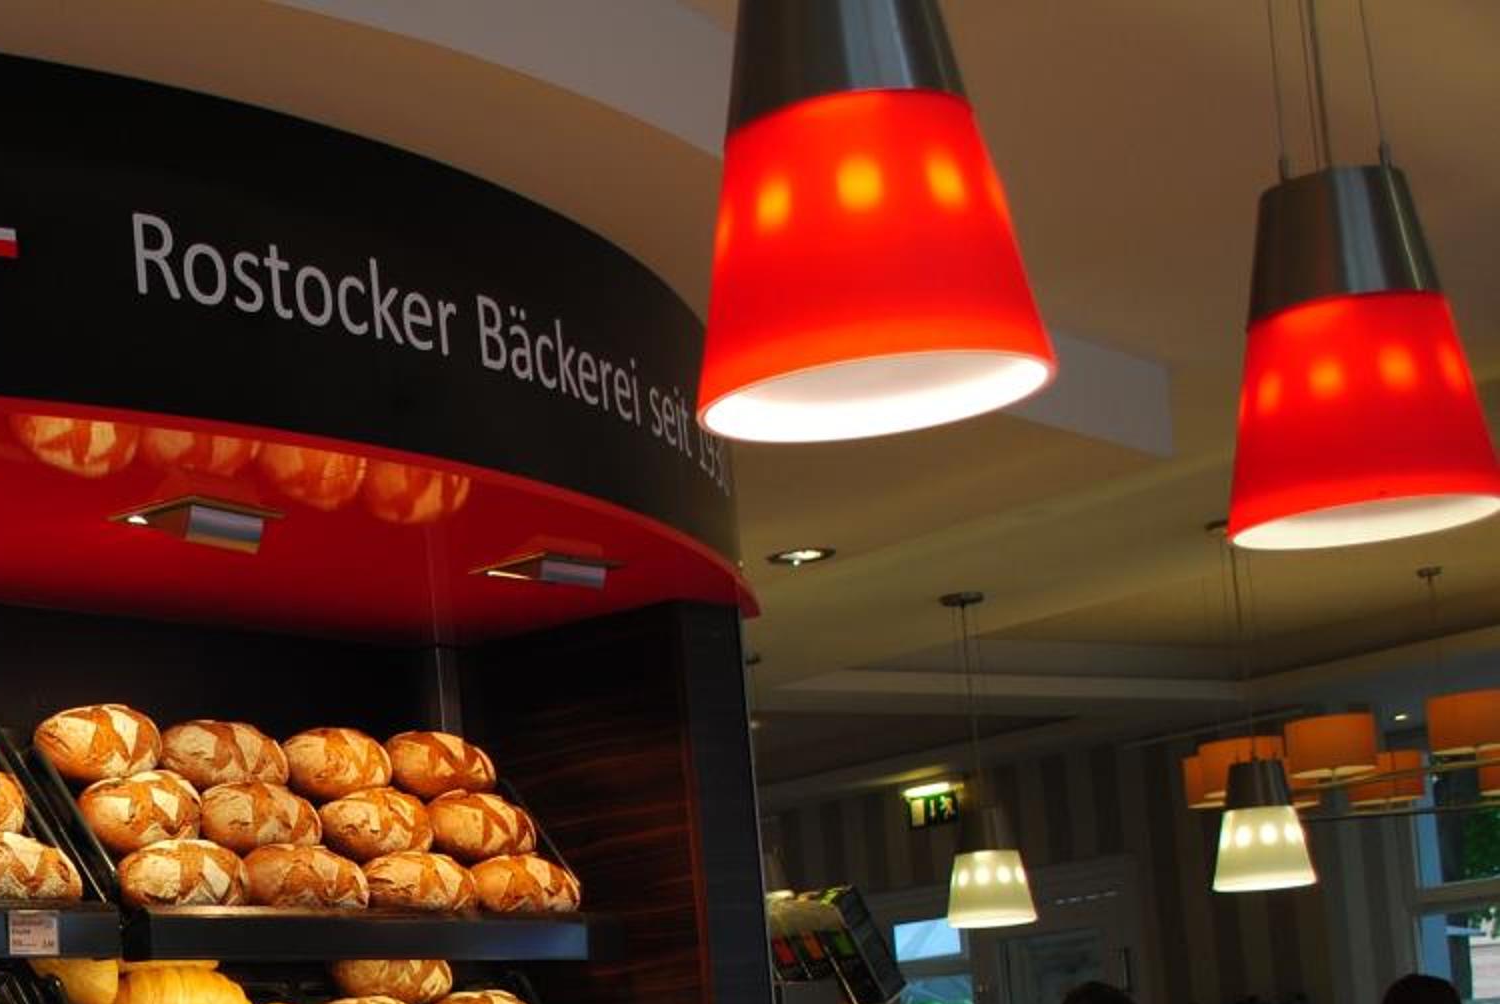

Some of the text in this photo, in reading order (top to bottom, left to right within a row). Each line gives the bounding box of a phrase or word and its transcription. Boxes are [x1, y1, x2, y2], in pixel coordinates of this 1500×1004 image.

[131, 212, 458, 357] Rostocker
[474, 294, 643, 426] Bäckerei
[648, 386, 693, 459] seit
